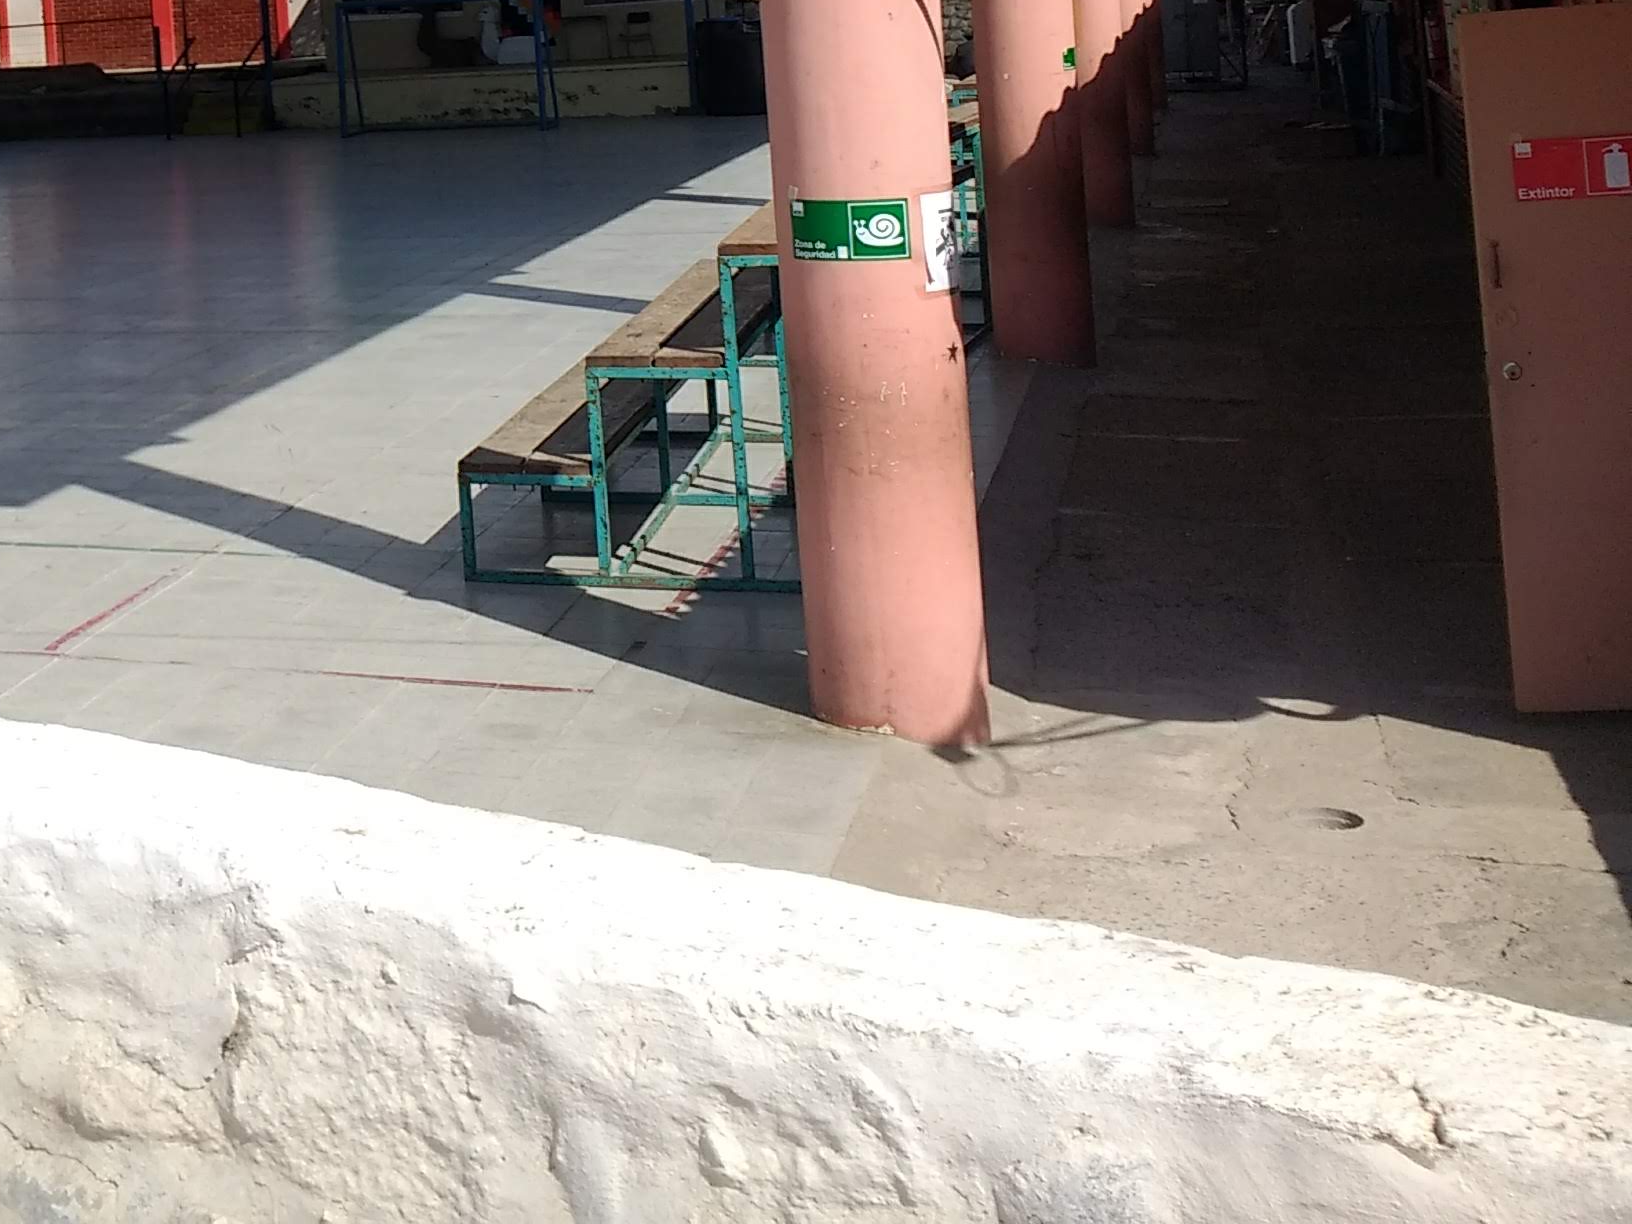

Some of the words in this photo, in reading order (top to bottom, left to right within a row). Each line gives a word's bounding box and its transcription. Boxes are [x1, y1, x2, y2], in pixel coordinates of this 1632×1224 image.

[1517, 186, 1576, 200] Extintor
[794, 238, 813, 249] Zona
[814, 239, 827, 249] de
[795, 249, 836, 260] Seguridad
